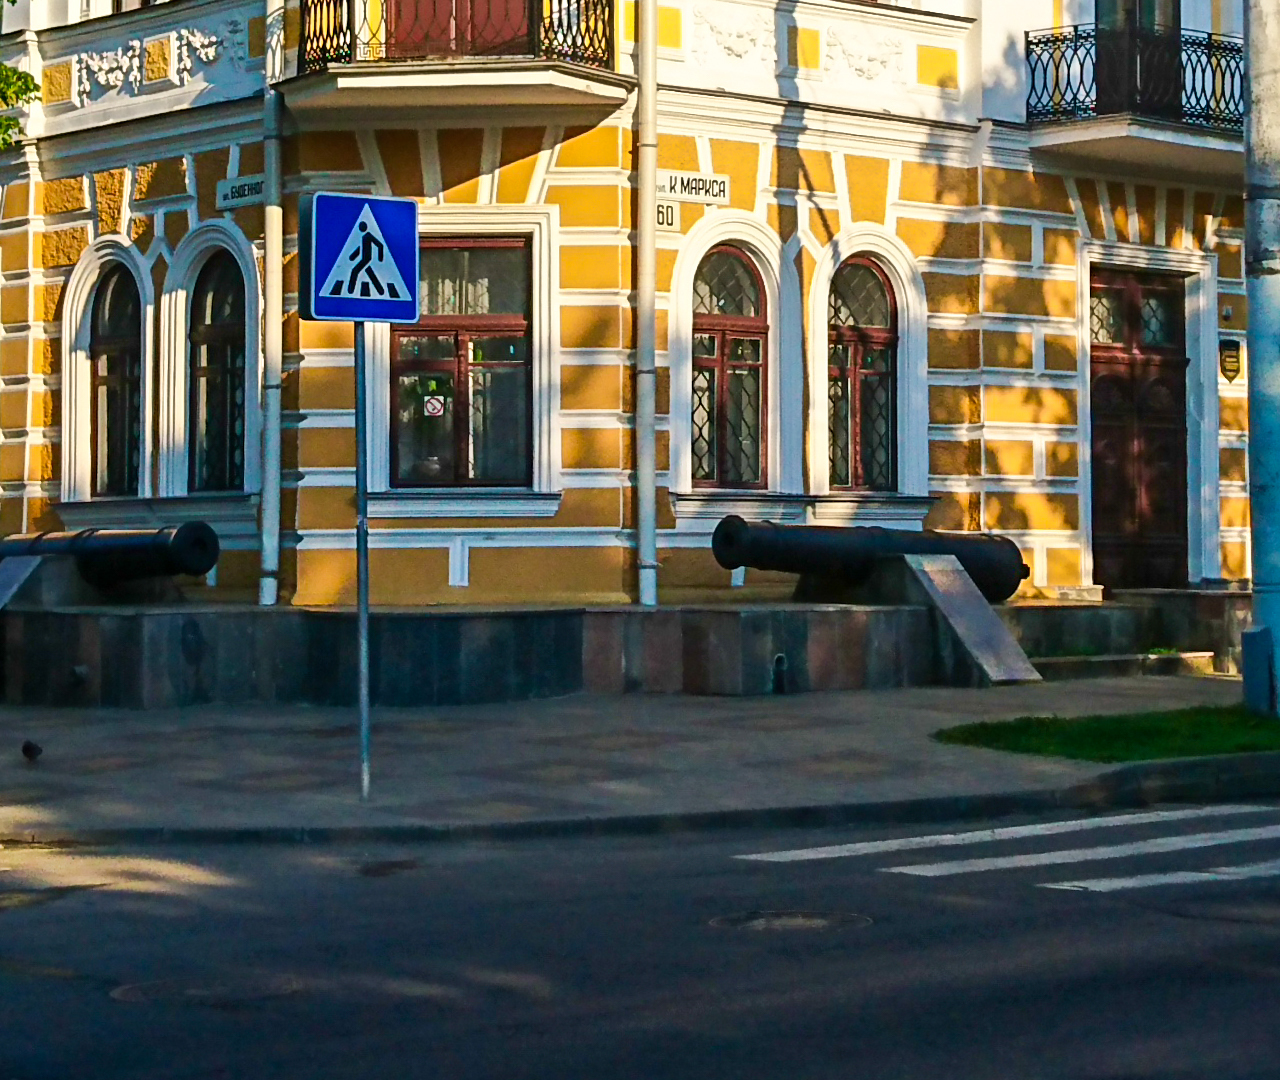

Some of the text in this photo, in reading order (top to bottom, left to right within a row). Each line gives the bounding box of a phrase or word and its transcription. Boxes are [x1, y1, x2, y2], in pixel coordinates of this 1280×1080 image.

[230, 181, 265, 199] БУДЕННОГ
[669, 175, 677, 194] К
[680, 176, 726, 198] МАРКСА
[656, 204, 673, 226] 60
